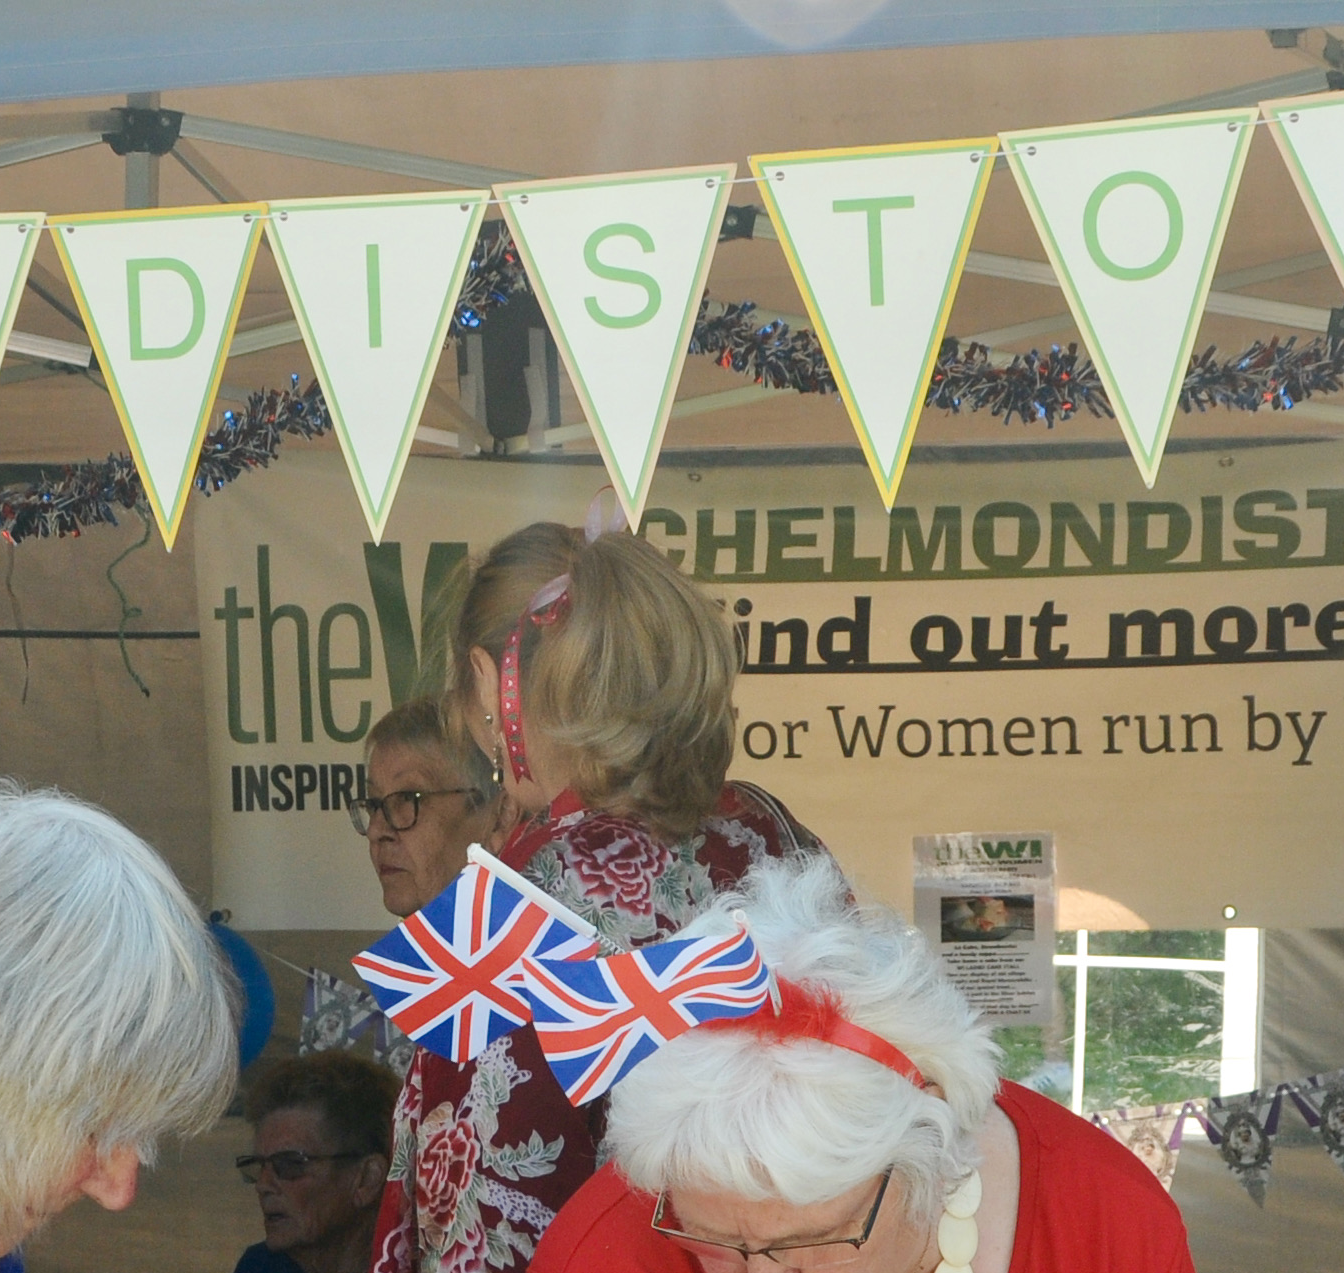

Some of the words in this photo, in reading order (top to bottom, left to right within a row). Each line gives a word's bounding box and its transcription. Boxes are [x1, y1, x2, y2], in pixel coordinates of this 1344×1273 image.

[910, 601, 1069, 662] out
[826, 705, 1082, 758] Women
[1103, 705, 1222, 754] run
[1243, 695, 1326, 766] by
